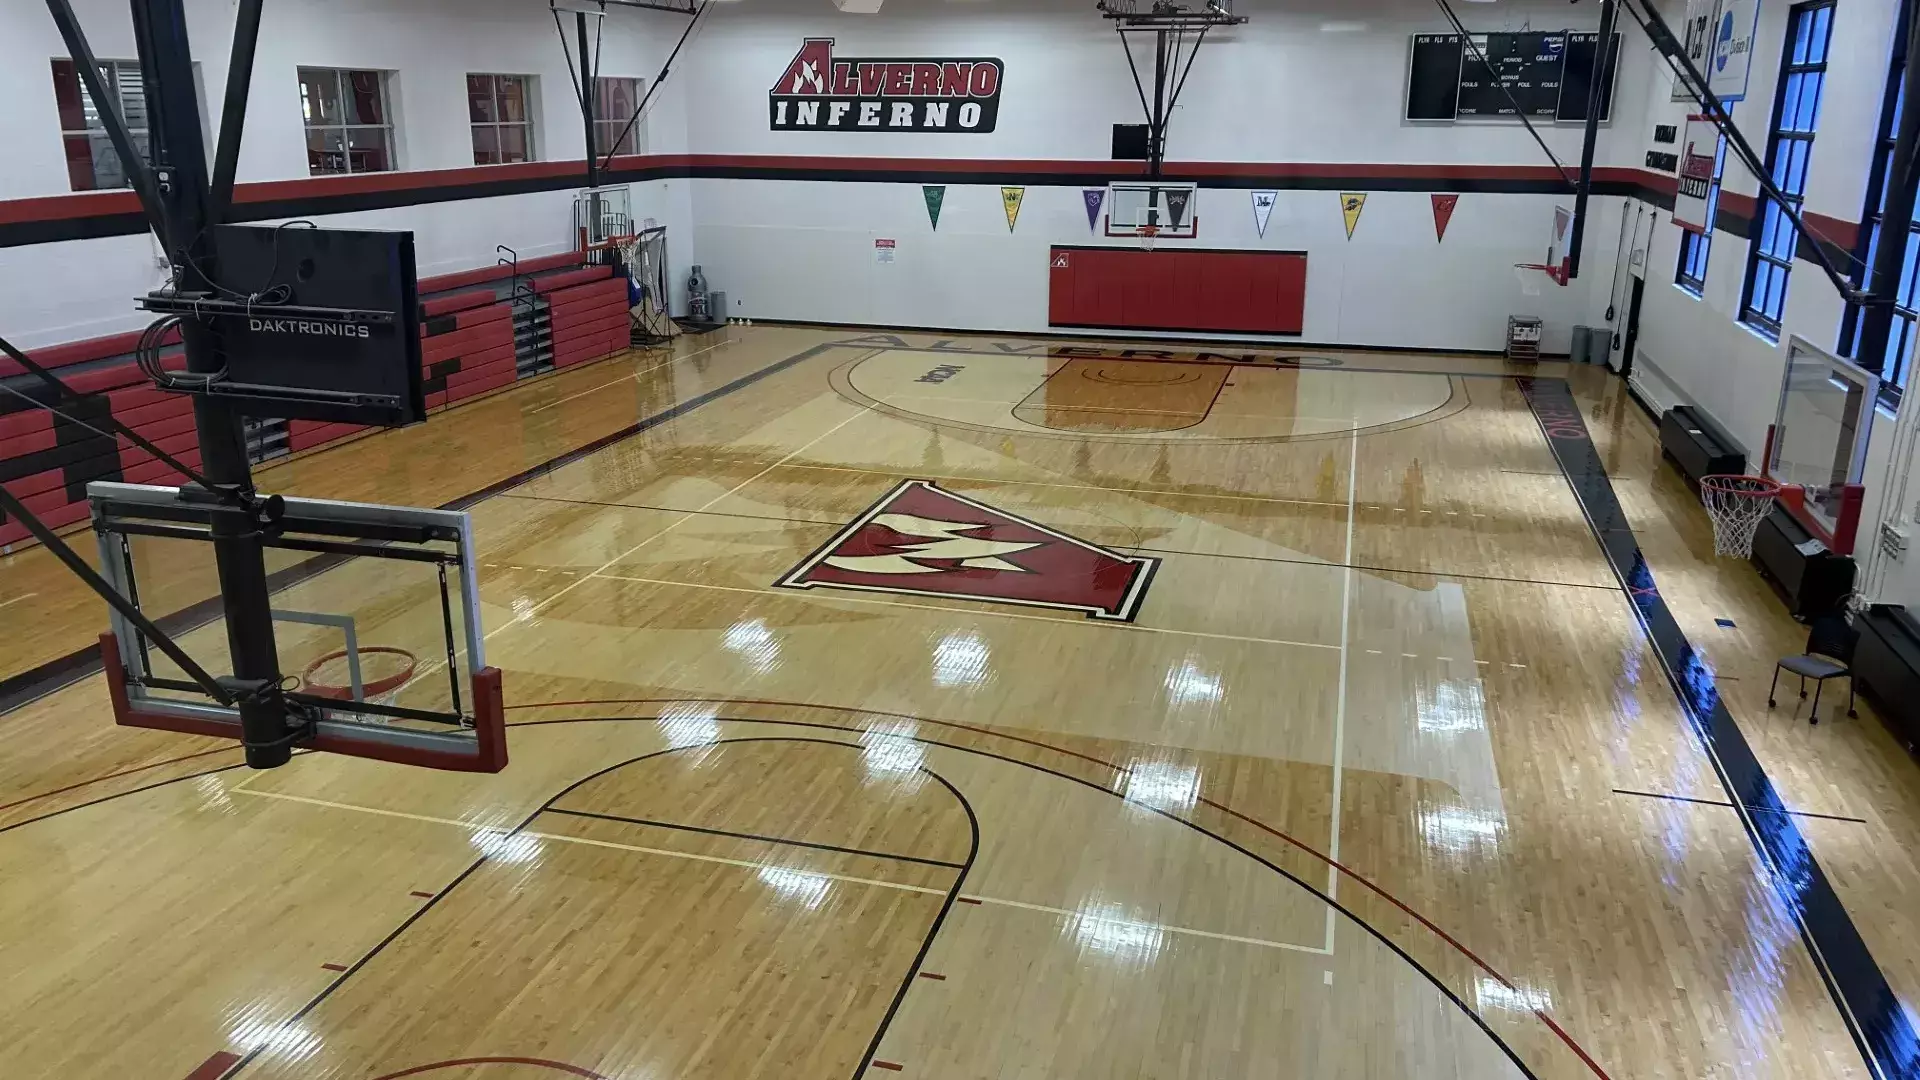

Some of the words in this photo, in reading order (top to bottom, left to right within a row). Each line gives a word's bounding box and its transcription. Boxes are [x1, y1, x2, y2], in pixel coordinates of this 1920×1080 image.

[769, 38, 1001, 98] ALVERNO
[1536, 54, 1558, 62] GUEST
[775, 101, 981, 127] INFERNO
[250, 318, 370, 338] DAKTRONICS
[835, 334, 1344, 366] ALVERNO
